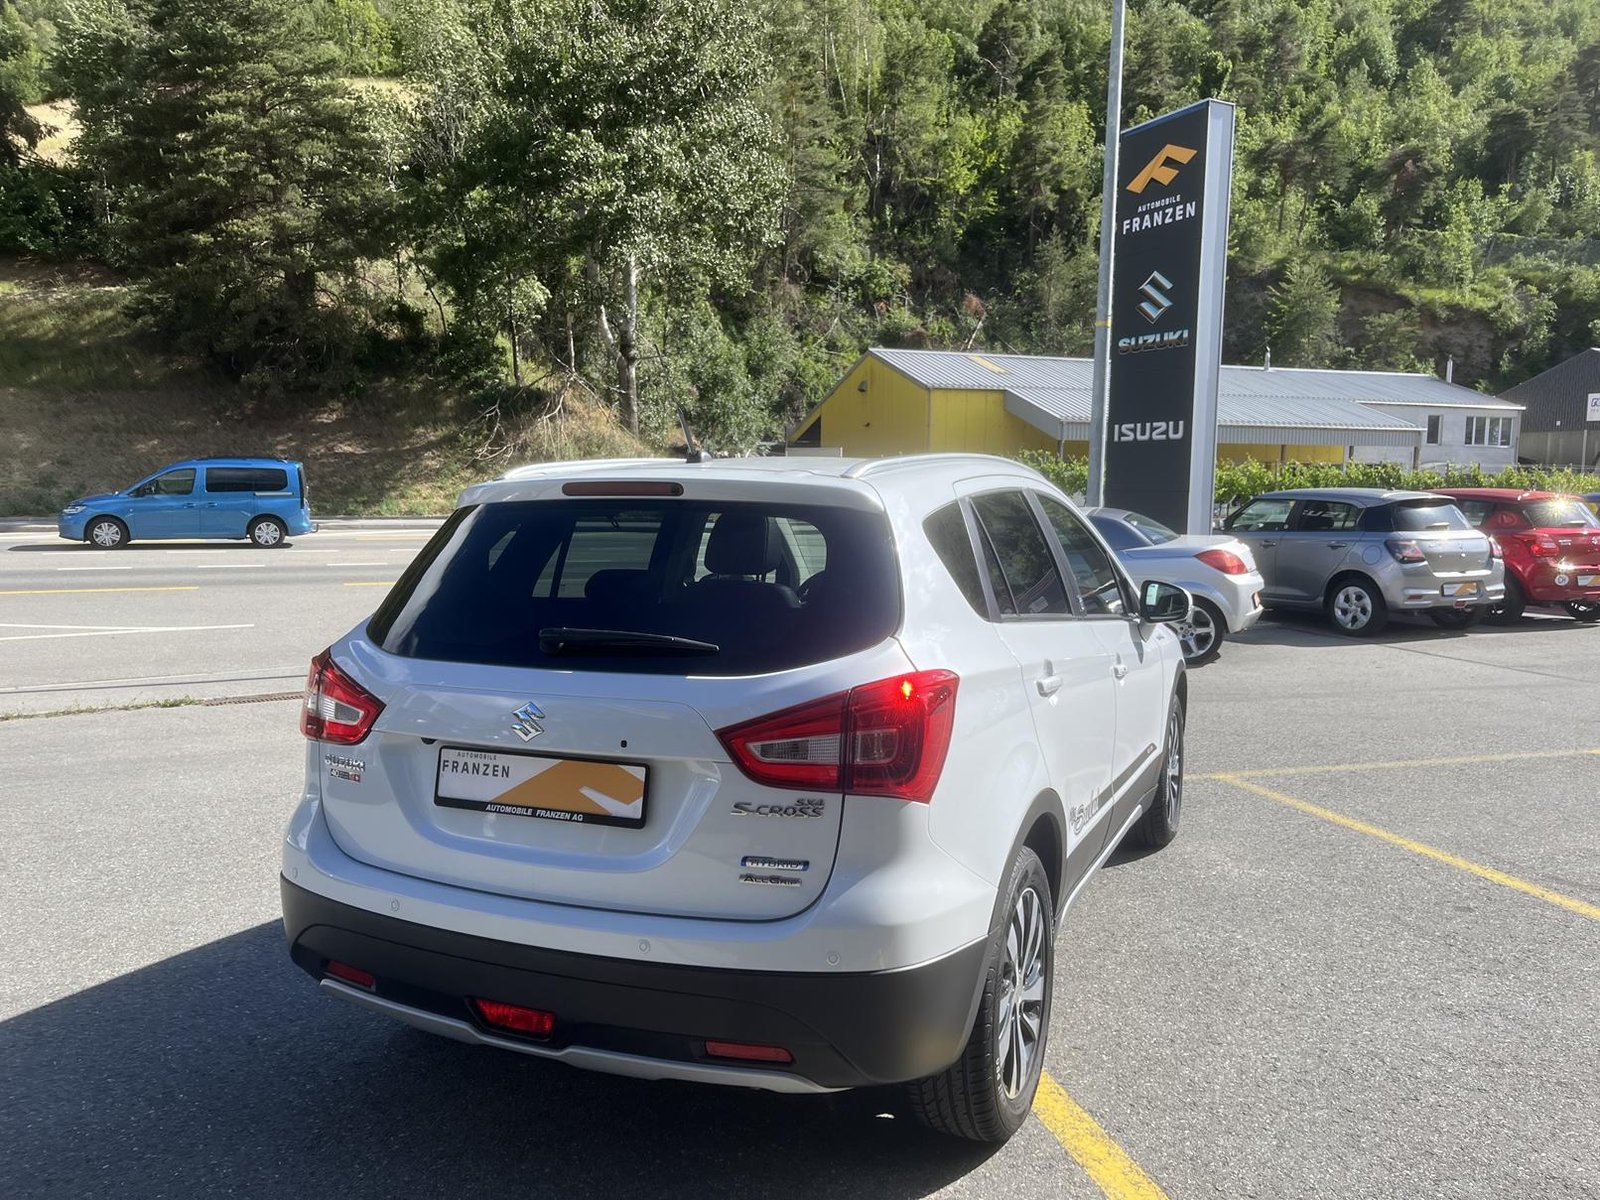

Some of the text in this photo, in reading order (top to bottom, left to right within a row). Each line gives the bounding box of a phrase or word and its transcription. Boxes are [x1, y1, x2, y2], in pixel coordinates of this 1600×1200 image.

[1137, 194, 1181, 213] AUTOMOBILE
[1122, 201, 1196, 235] FRANZEN
[1118, 329, 1189, 355] SUZUKI
[1113, 420, 1184, 442] ISUZU
[457, 751, 497, 761] AUTOMOBILE
[442, 760, 510, 778] FRANZEN
[485, 804, 584, 822] AUTOMOBILE FRANZEN AG
